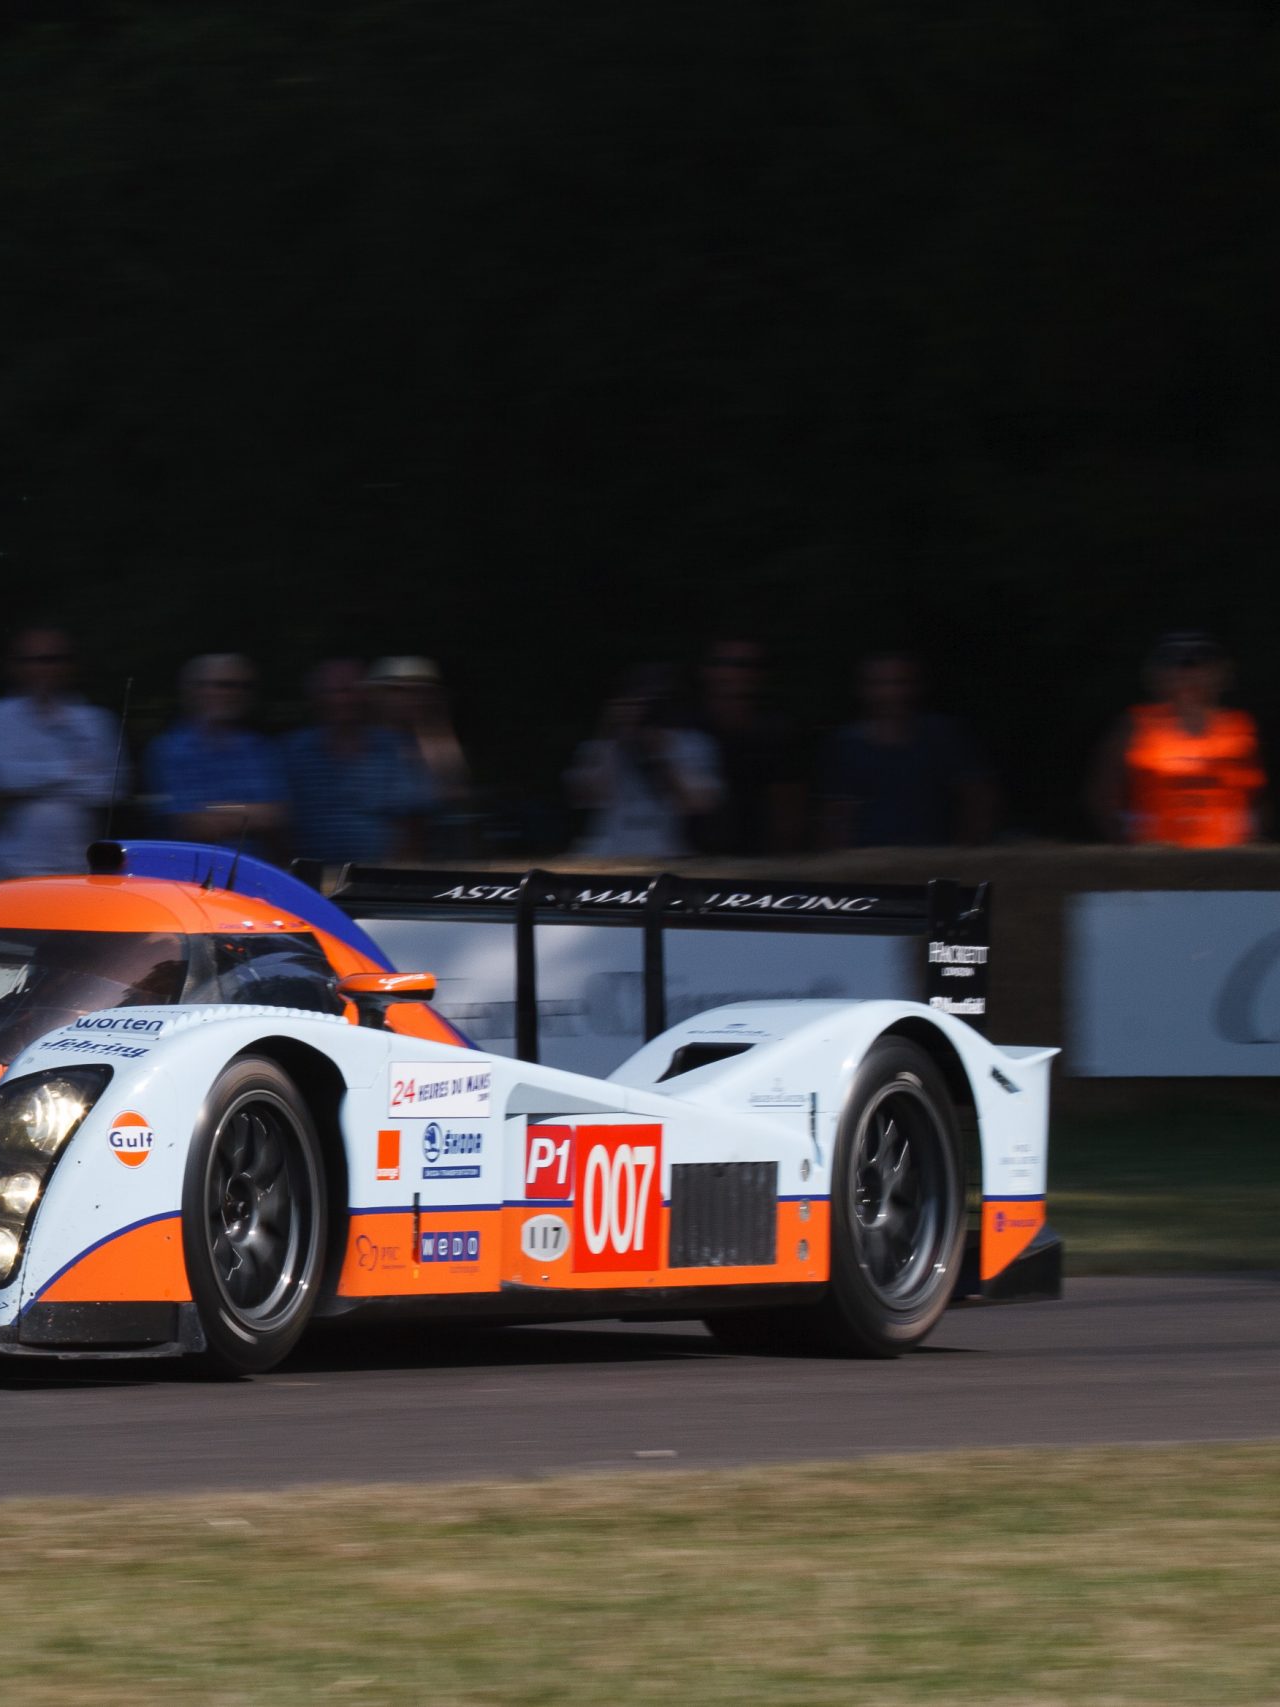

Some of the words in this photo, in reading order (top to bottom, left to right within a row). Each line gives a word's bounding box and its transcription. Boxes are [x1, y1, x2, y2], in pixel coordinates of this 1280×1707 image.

[718, 893, 880, 911] RACING
[74, 1017, 164, 1032] worten
[391, 1078, 415, 1106] 24
[417, 1081, 449, 1102] HEURES
[451, 1077, 465, 1096] DU
[466, 1073, 491, 1092] MANS
[109, 1131, 153, 1147] Gulf
[526, 1138, 570, 1184] P1
[583, 1144, 656, 1254] 007
[530, 1226, 562, 1249] 117
